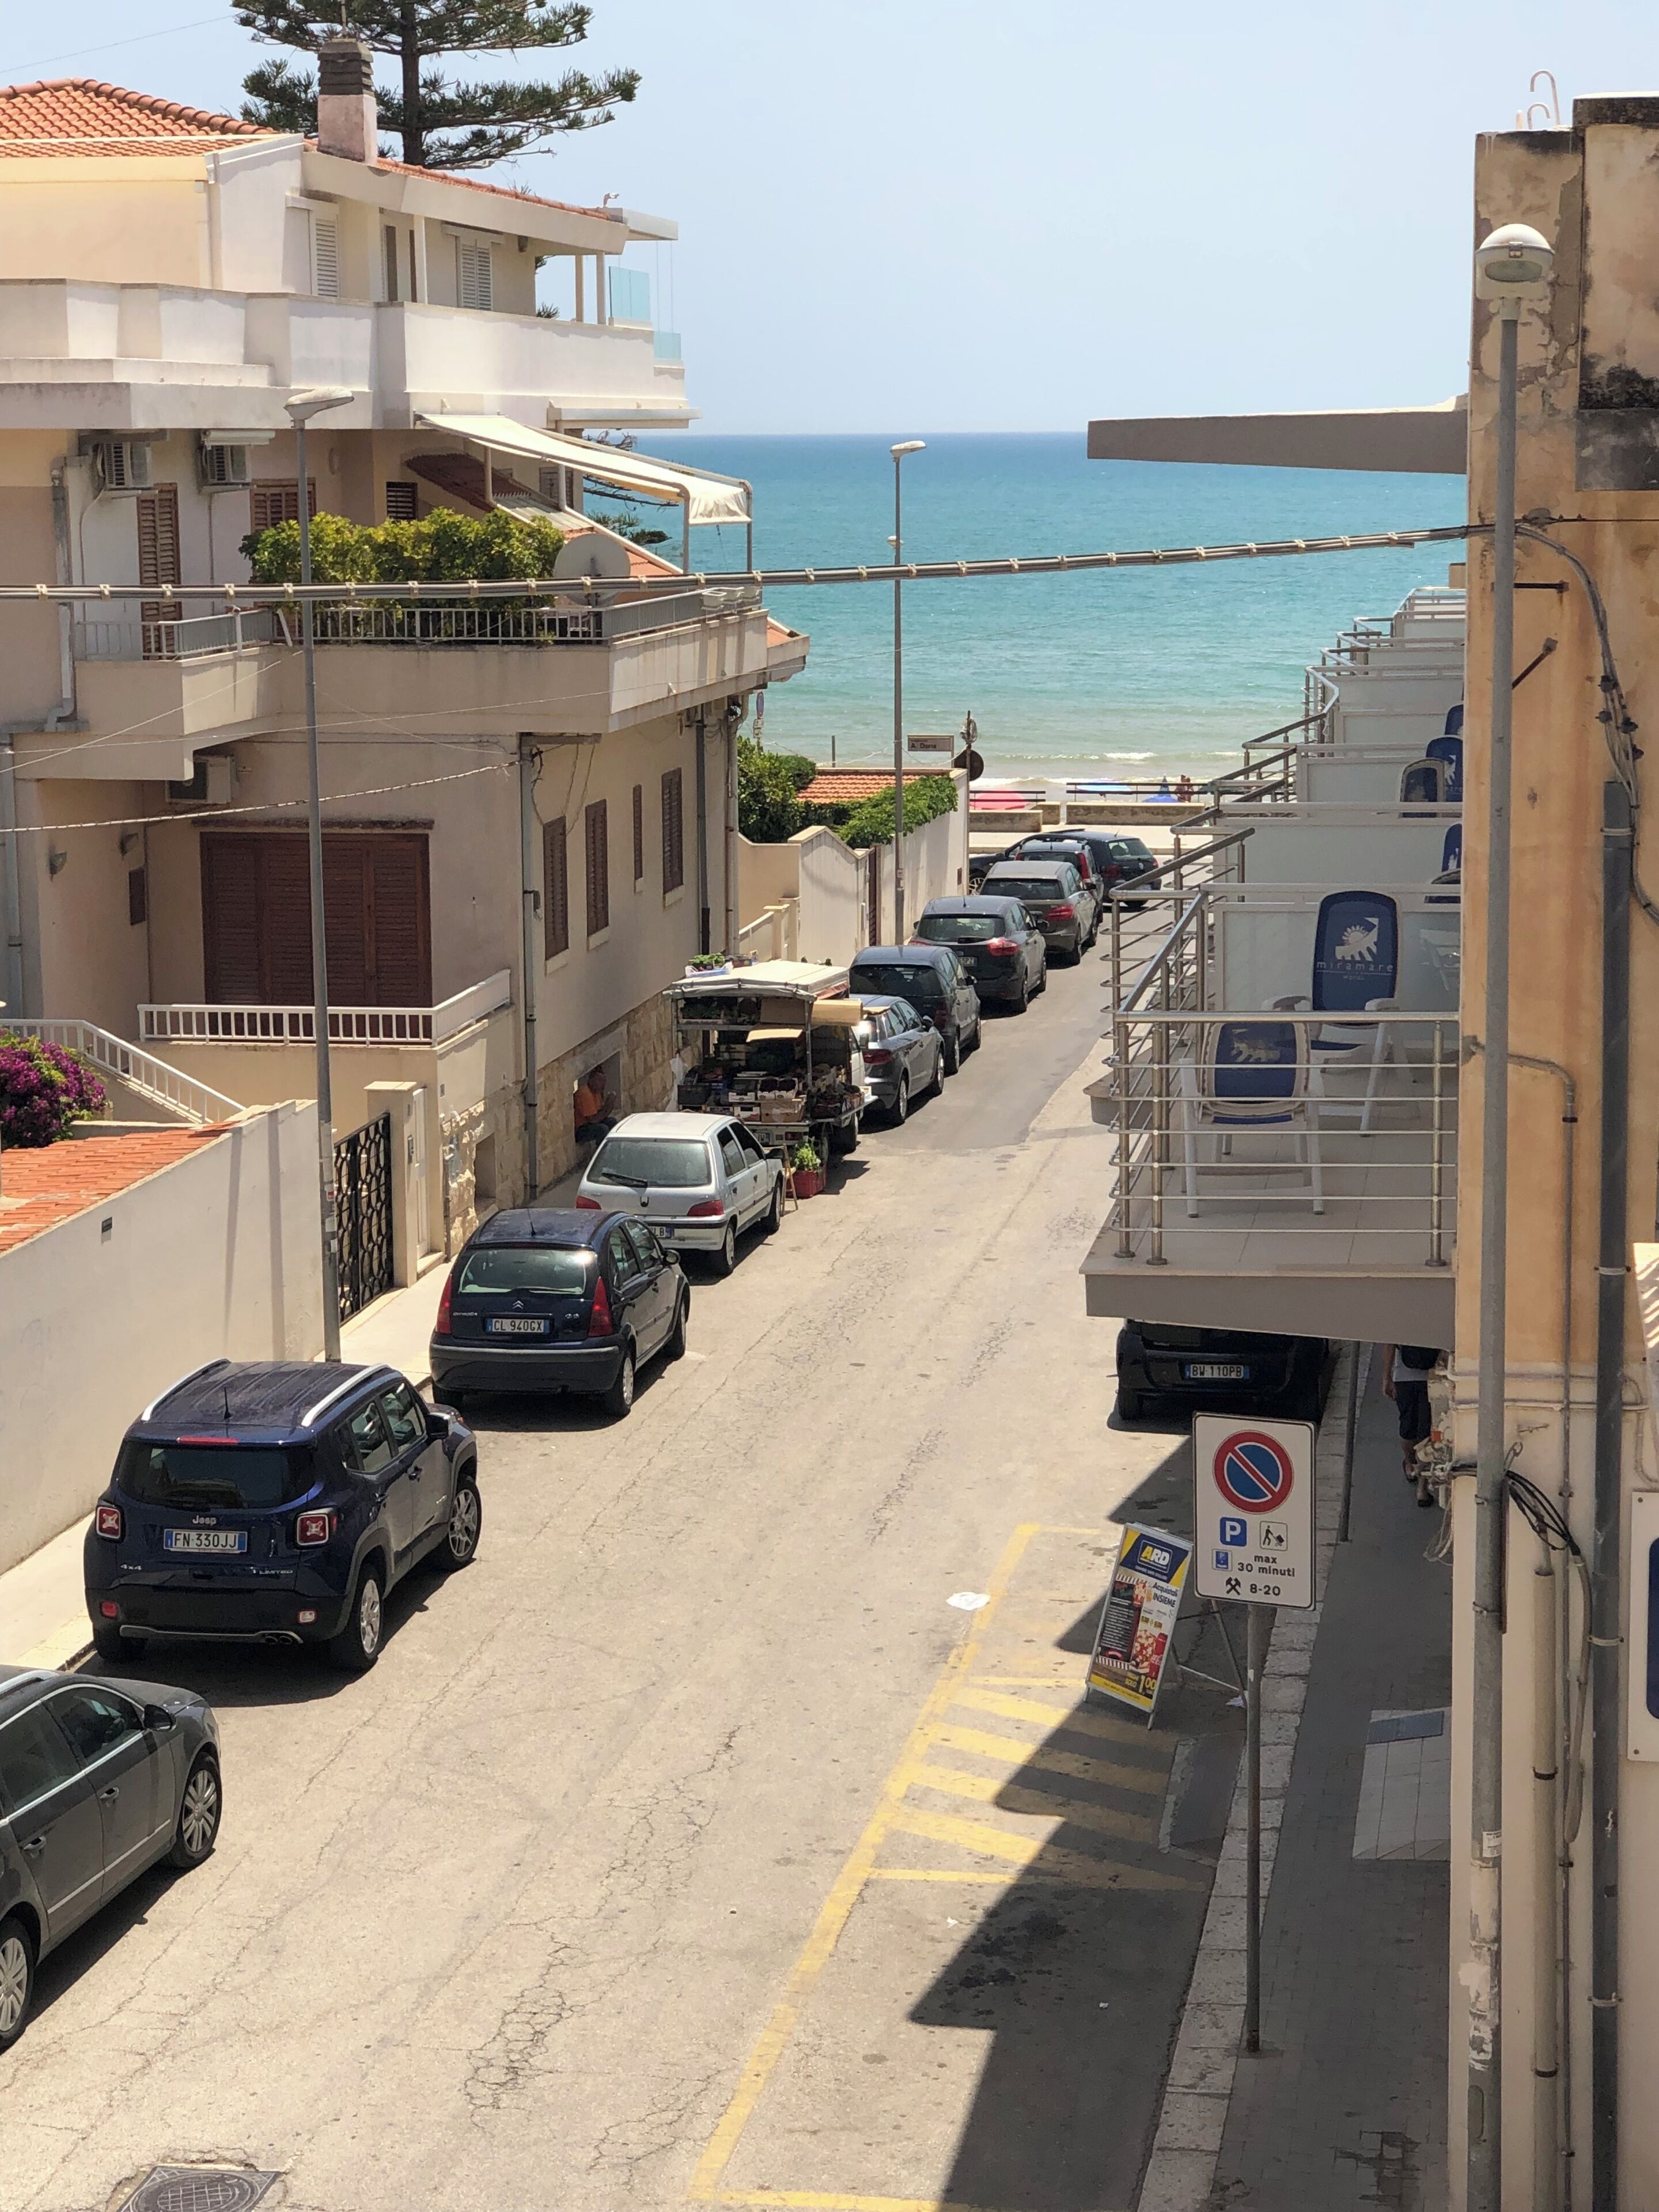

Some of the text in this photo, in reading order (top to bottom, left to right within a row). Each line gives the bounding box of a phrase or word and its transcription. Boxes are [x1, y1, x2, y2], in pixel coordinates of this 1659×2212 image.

[1316, 961, 1393, 972] miramare
[494, 1320, 542, 1332] CL 940GX
[192, 1515, 217, 1525] Jeep
[1225, 1521, 1241, 1542] P
[174, 1533, 237, 1548] FN 330JJ
[1141, 1546, 1170, 1566] ARD
[1253, 1555, 1278, 1564] max
[1237, 1562, 1295, 1577] 30 minuti
[1249, 1583, 1281, 1596] 8-20
[1153, 1592, 1176, 1608] INSIEME
